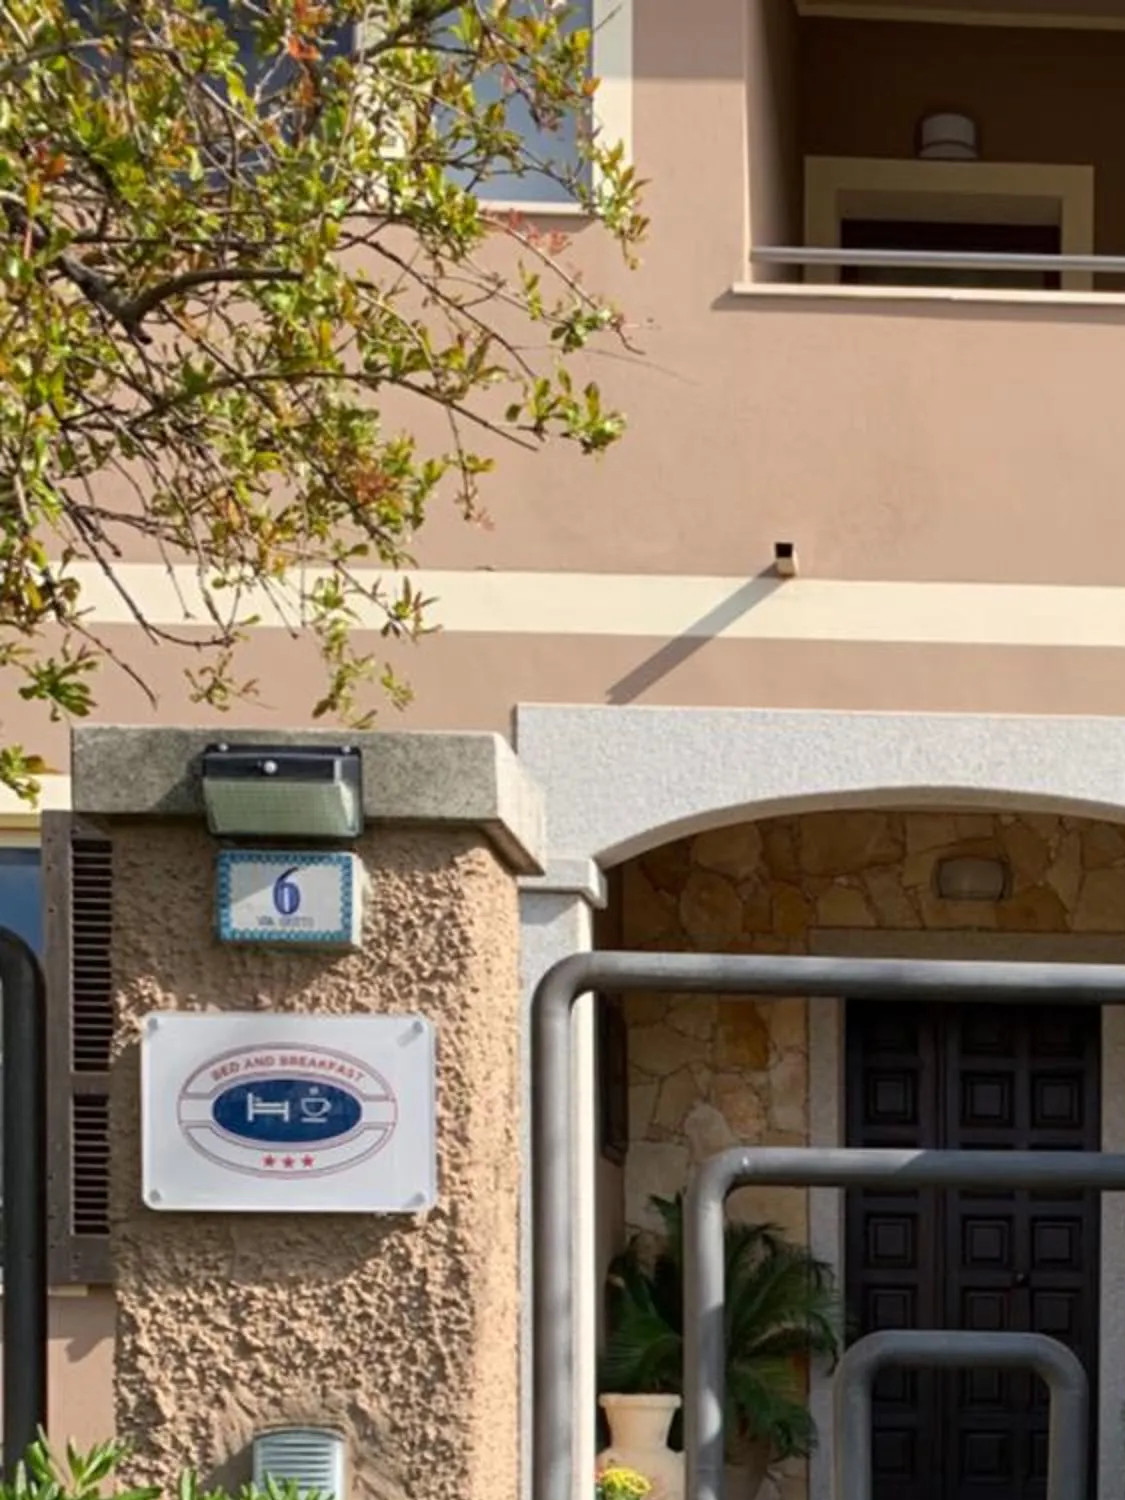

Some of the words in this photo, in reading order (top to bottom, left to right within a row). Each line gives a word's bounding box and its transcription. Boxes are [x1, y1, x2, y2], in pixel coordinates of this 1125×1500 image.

[273, 866, 301, 915] 6
[211, 1061, 240, 1081] BED
[244, 1055, 275, 1069] AND
[280, 1055, 366, 1081] BREAKFAST
